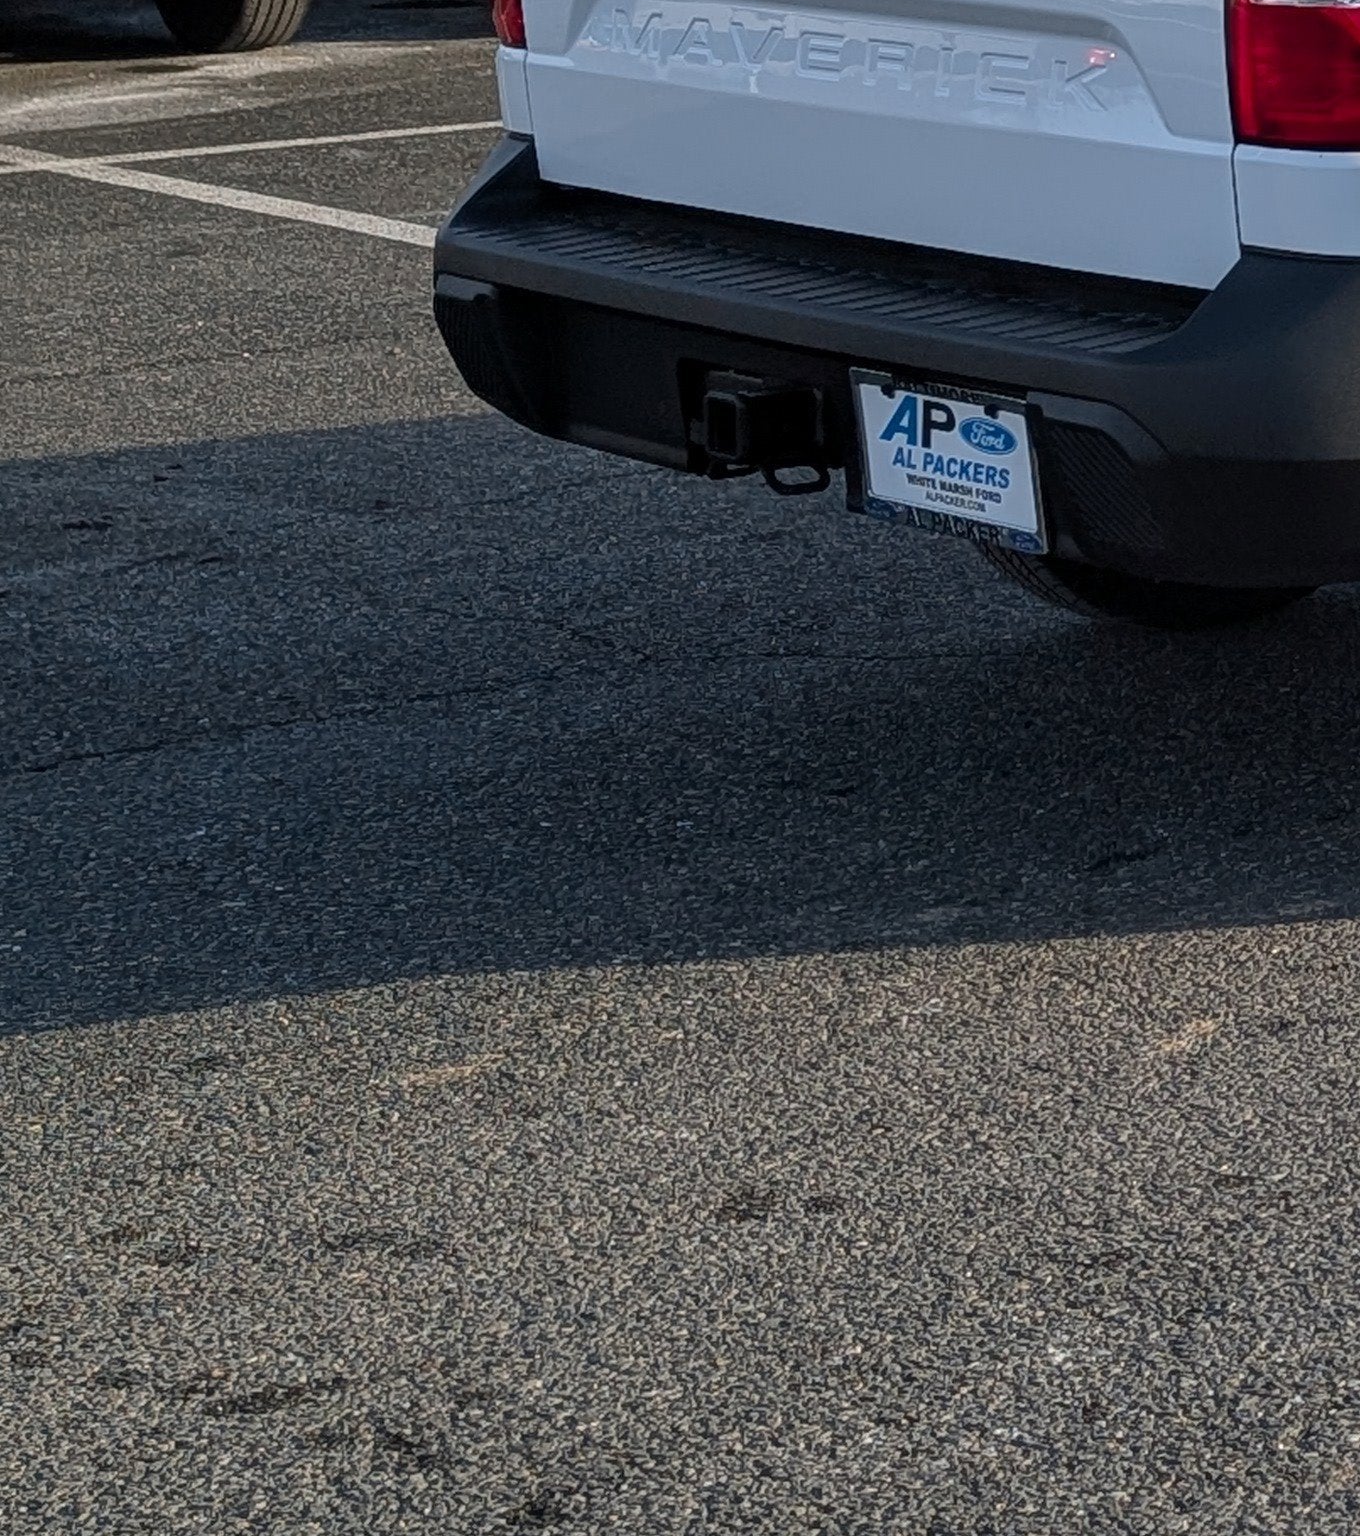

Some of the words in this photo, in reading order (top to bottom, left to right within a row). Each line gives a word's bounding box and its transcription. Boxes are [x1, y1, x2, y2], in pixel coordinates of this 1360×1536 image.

[608, 7, 1108, 112] MAVERICK
[878, 394, 957, 449] AP
[970, 421, 1006, 450] Ford
[892, 447, 916, 469] AL
[922, 452, 1011, 489] PACKERS
[906, 473, 937, 490] WHITE
[939, 480, 973, 498] MARSH
[975, 488, 1002, 504] FORD
